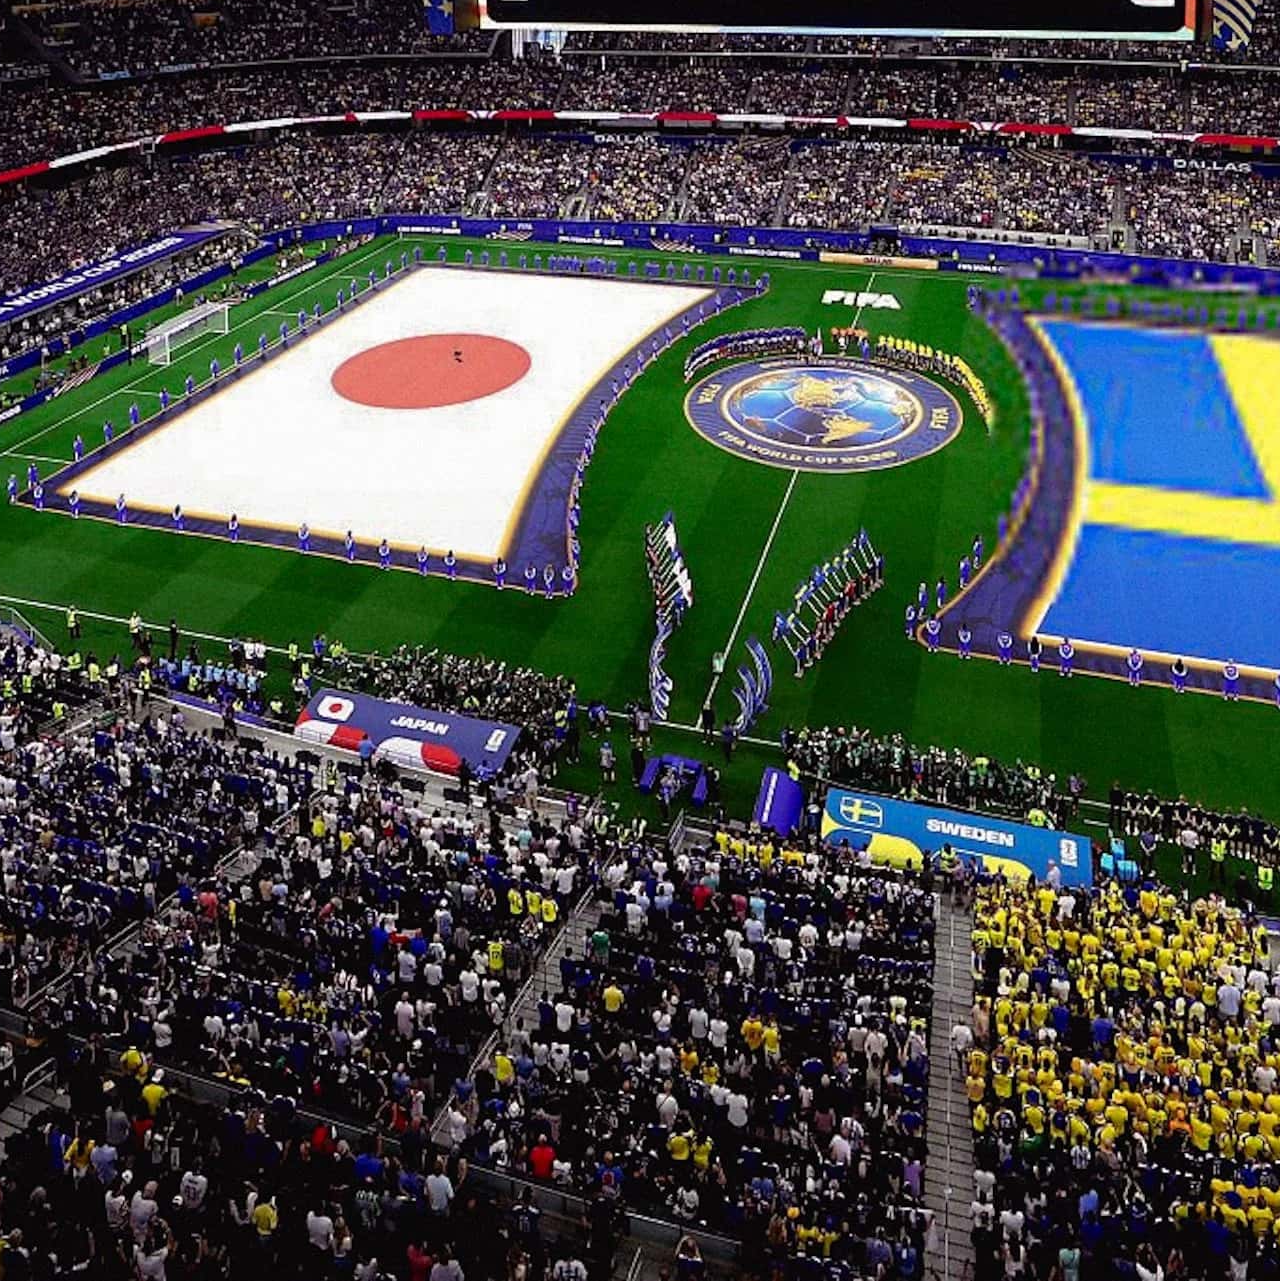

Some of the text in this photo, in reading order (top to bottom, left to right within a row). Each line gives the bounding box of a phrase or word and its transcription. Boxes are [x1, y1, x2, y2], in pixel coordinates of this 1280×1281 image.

[1173, 158, 1251, 172] DALLAS
[10, 275, 86, 308] WORLD
[81, 259, 121, 279] CUP
[821, 290, 901, 310] FIFA
[929, 407, 949, 430] FIFA
[718, 431, 746, 447] FIFA
[747, 444, 802, 461] WORLD
[804, 455, 837, 465] CUP
[390, 716, 450, 735] JAPAN
[926, 818, 1015, 848] SWEDEN
